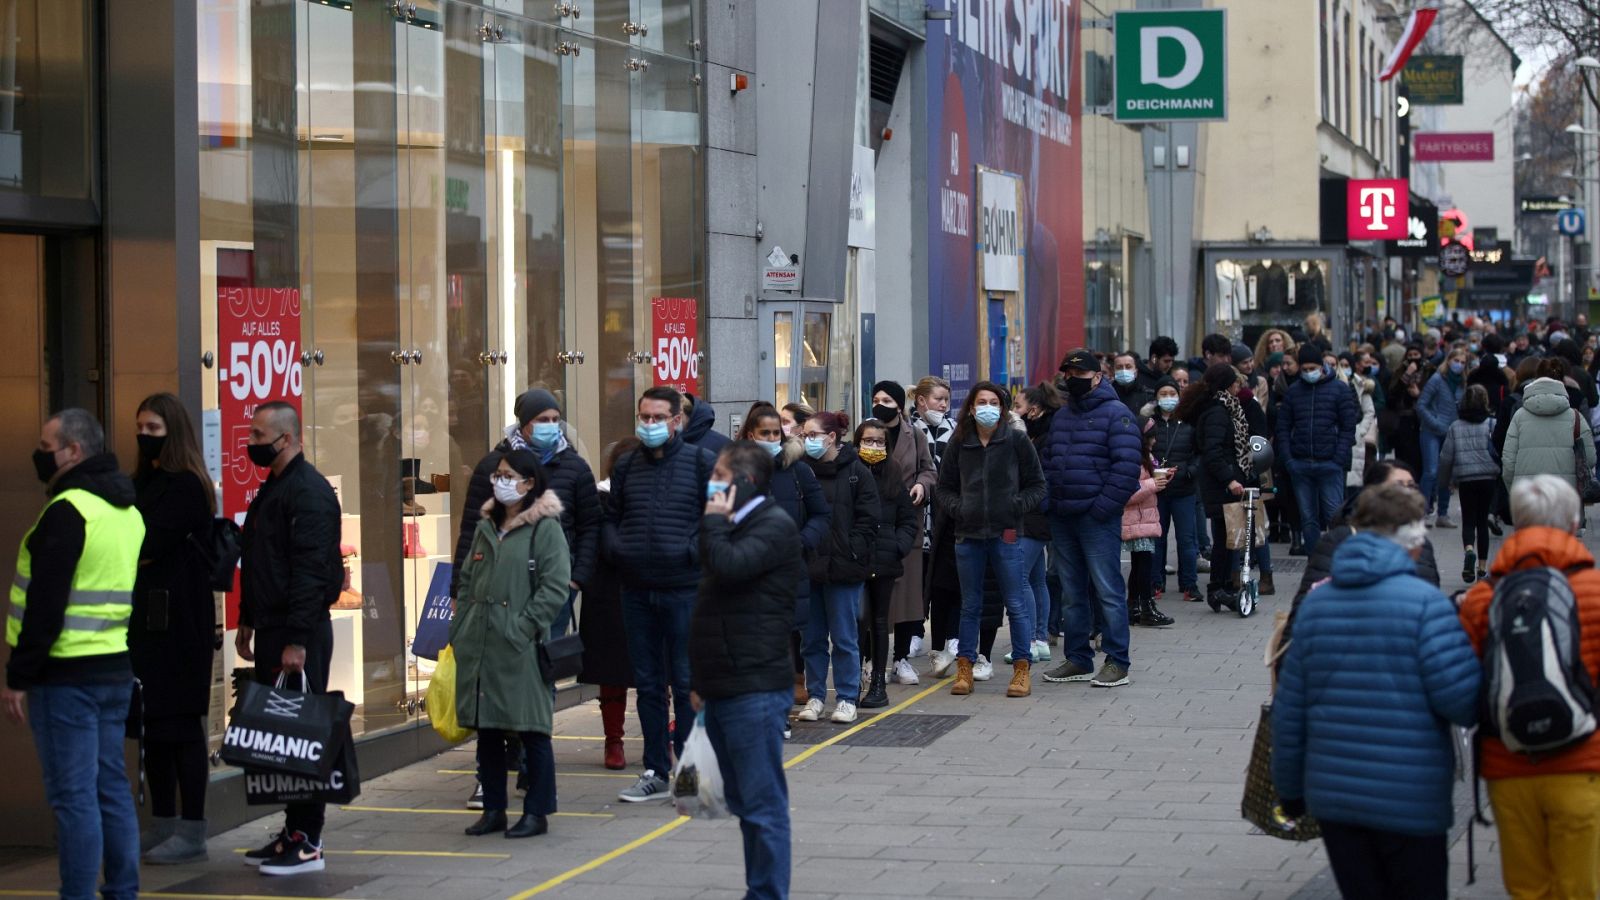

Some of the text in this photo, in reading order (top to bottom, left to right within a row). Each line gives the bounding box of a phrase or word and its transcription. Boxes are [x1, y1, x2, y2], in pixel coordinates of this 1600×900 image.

[1140, 26, 1204, 90] D
[1126, 98, 1214, 110] DEICHMANN
[951, 131, 959, 176] AB
[941, 180, 957, 235] MÄRZ
[1360, 187, 1395, 231] T
[1563, 214, 1581, 232] U
[242, 321, 281, 336] AUF ALLES
[220, 339, 303, 401] -50%
[652, 336, 698, 381] -50%
[224, 725, 323, 762] HUMANIC
[246, 770, 344, 794] HUMANC
